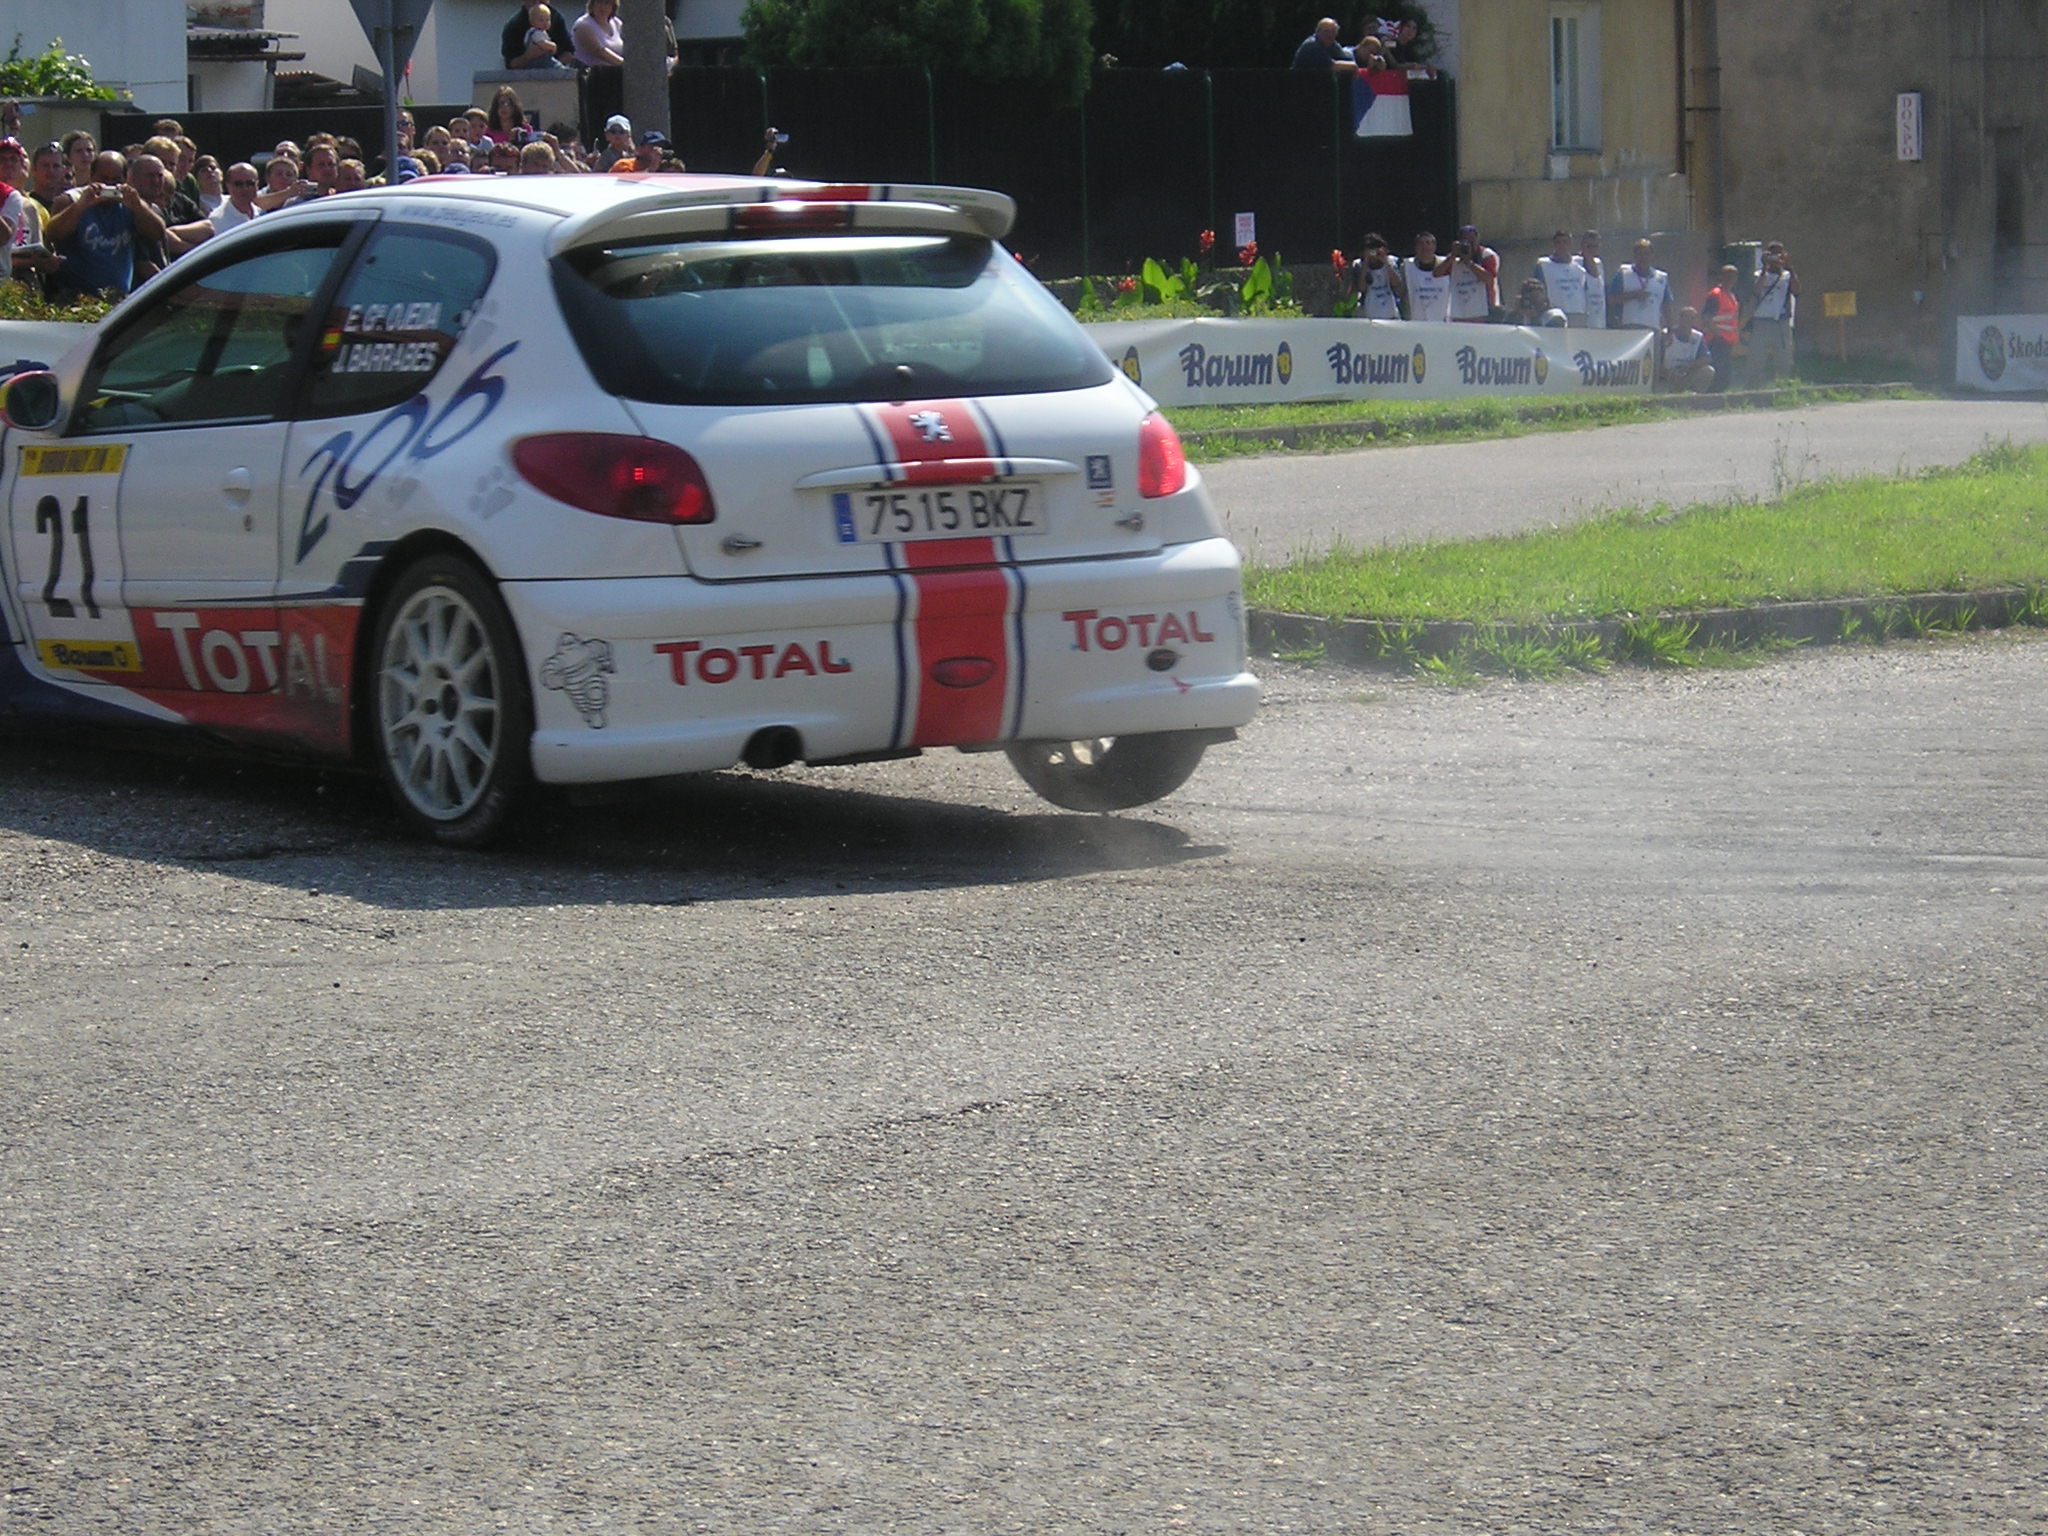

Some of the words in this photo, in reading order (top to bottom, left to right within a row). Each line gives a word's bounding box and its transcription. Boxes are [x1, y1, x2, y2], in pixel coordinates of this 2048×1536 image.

[1179, 343, 1273, 387] Barum
[1326, 342, 1410, 384] Barum
[1455, 345, 1531, 385] Barum
[1573, 350, 1641, 386] Barum
[296, 339, 521, 566] 206
[865, 491, 960, 535] 7515
[968, 488, 1034, 529] BKZ
[36, 495, 101, 619] 21
[1062, 609, 1215, 652] TOTAL
[153, 611, 343, 703] TOTAL
[653, 640, 854, 686] TOTAL
